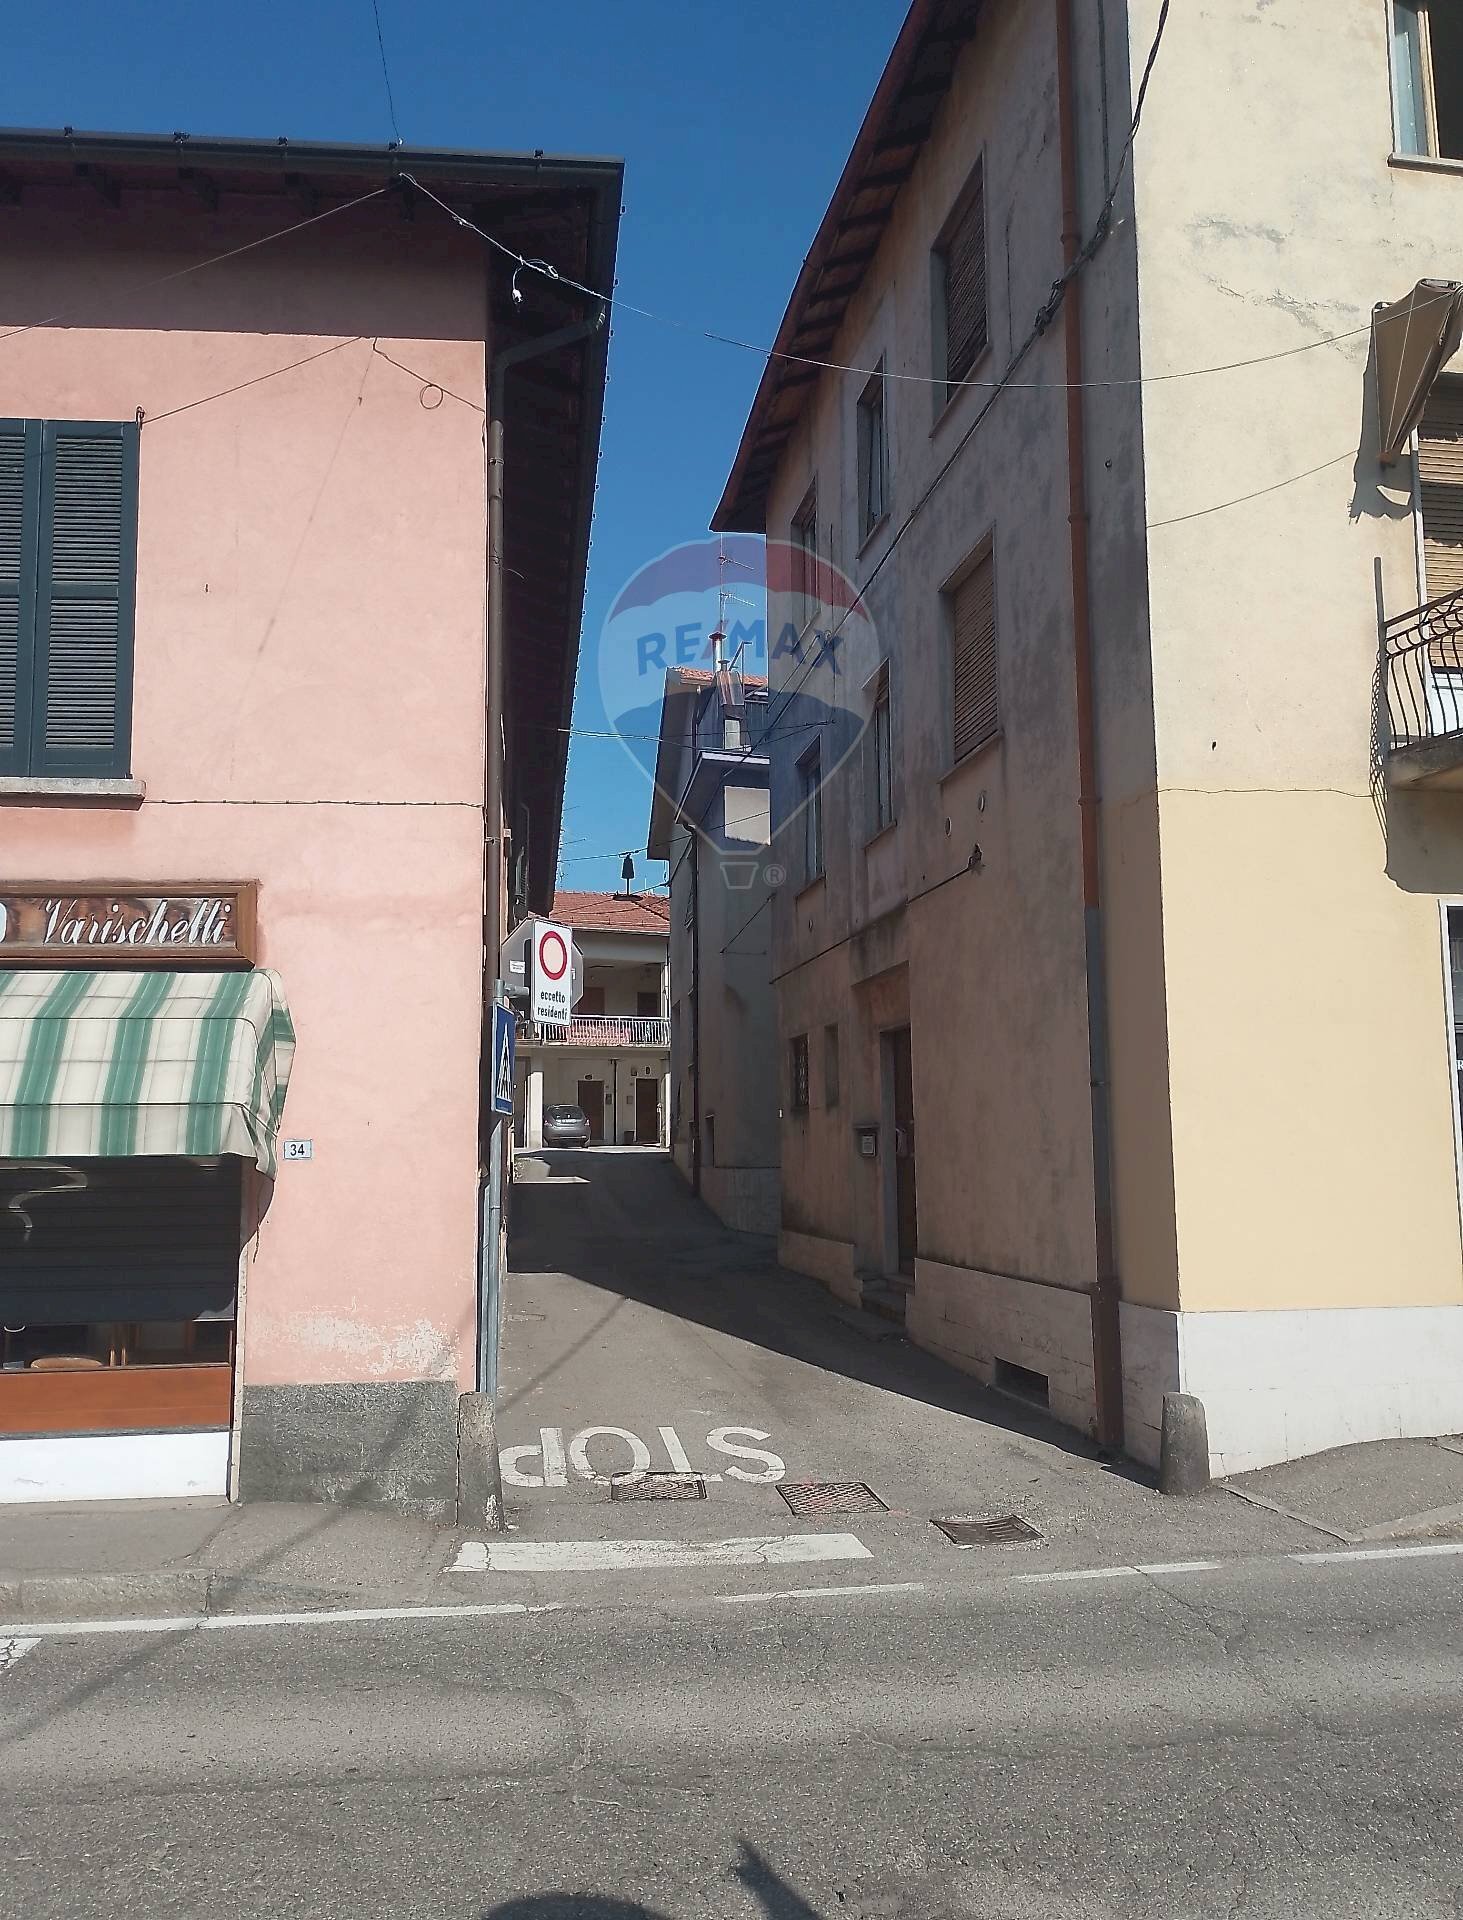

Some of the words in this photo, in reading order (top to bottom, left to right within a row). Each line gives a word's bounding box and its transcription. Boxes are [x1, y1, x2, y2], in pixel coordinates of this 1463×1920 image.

[540, 991, 566, 1004] eccetto
[537, 1005, 568, 1020] residenti
[290, 1144, 305, 1156] 34
[499, 1426, 786, 1488] STOP
